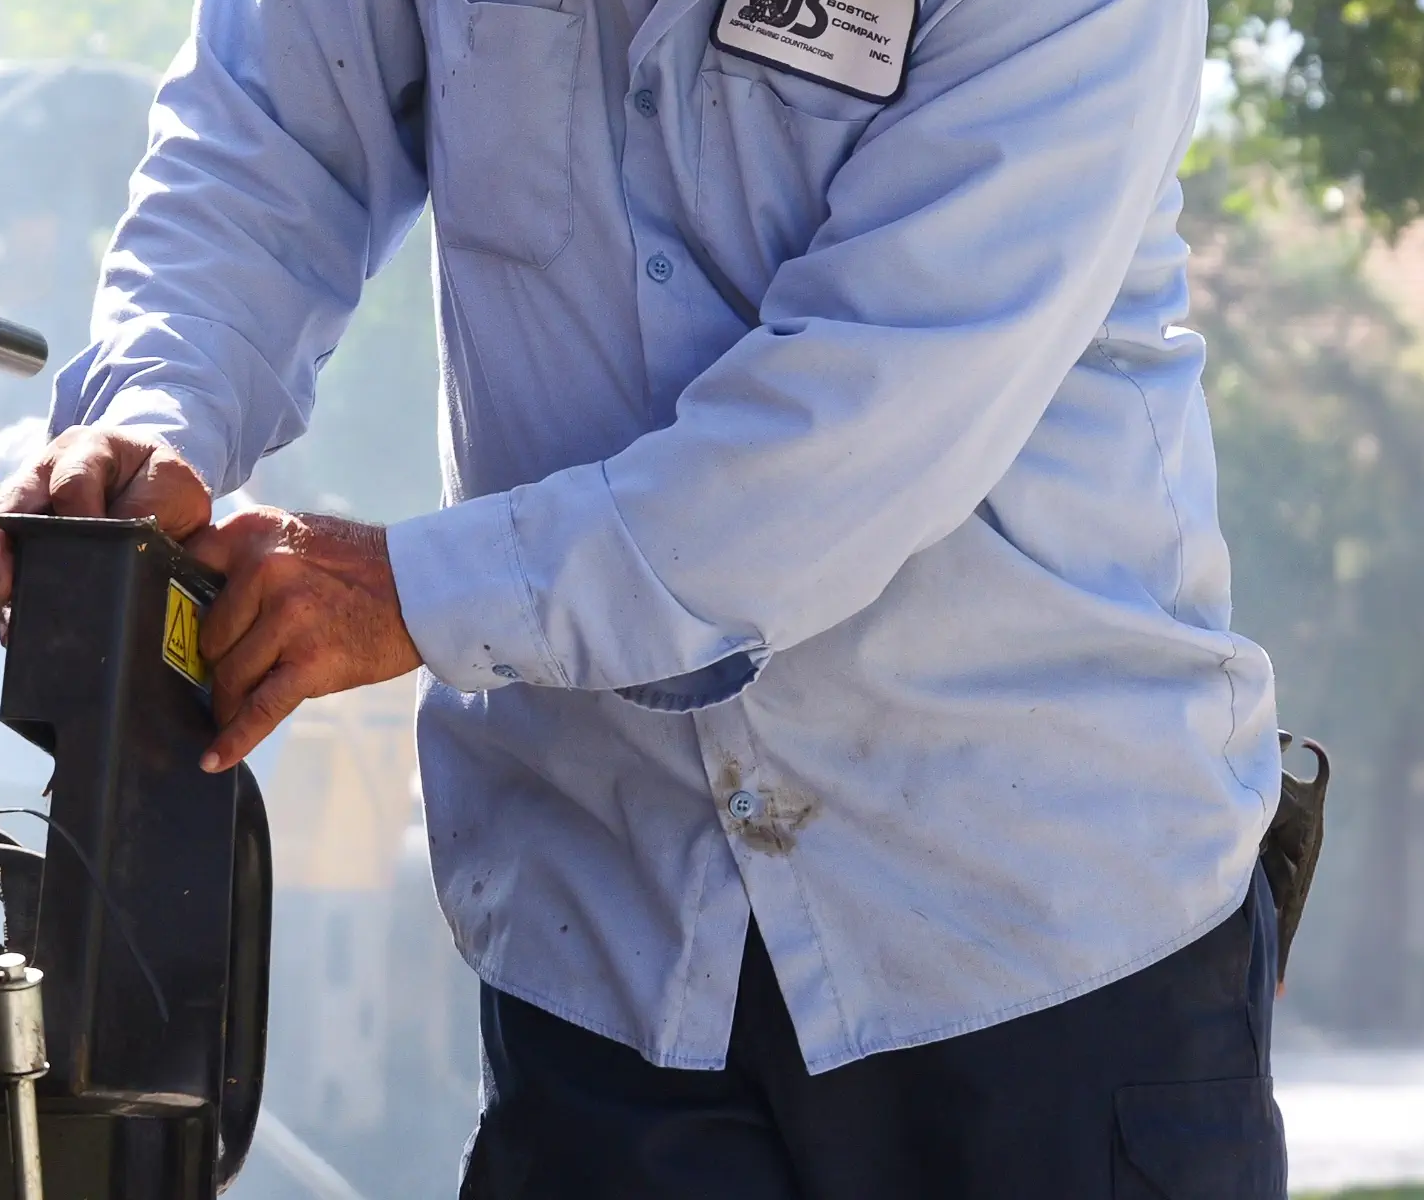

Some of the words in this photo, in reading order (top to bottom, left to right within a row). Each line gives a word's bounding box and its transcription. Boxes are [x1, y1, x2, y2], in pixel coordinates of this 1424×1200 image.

[728, 18, 756, 32] ASPHALT
[756, 27, 780, 40] PAVING
[831, 17, 892, 47] COMPANY
[869, 49, 894, 66] INC.
